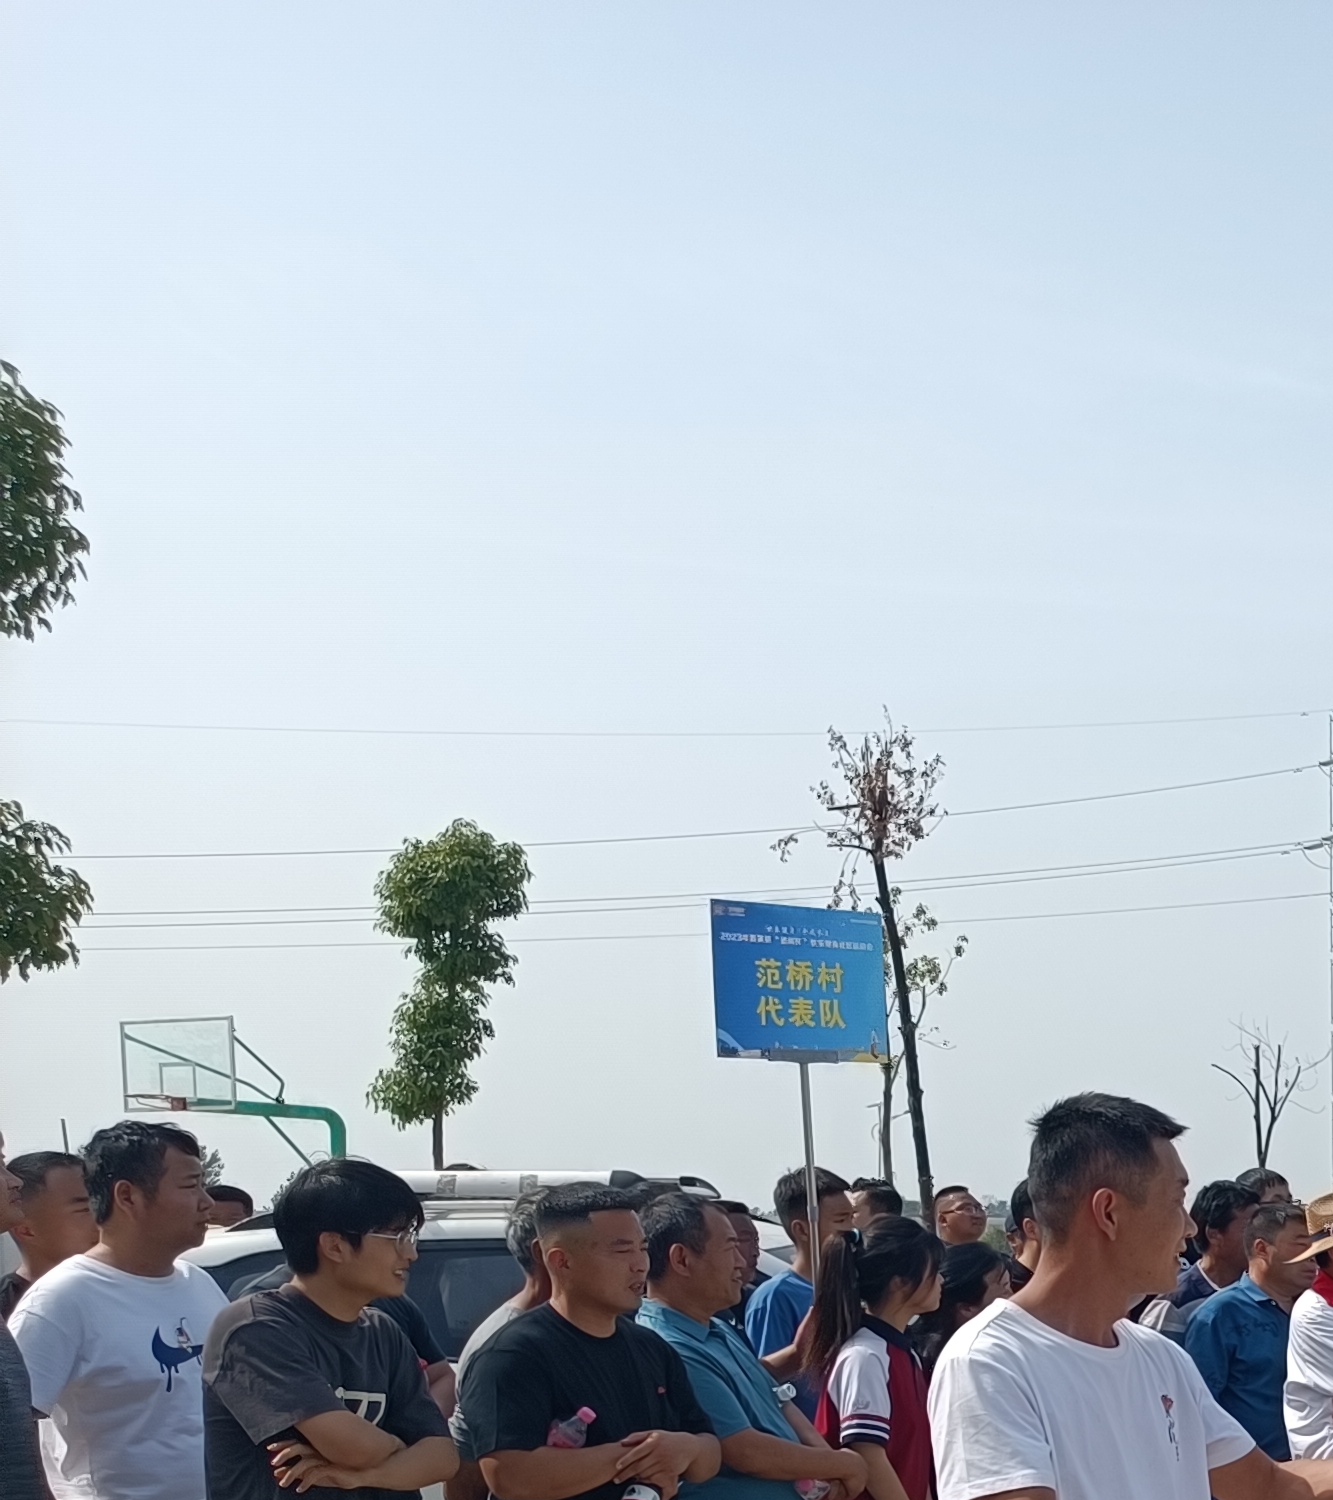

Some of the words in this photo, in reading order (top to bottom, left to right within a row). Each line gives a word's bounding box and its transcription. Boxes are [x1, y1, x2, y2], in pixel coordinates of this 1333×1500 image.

[754, 957, 844, 993] 范桥村
[756, 995, 847, 1029] 代表队
